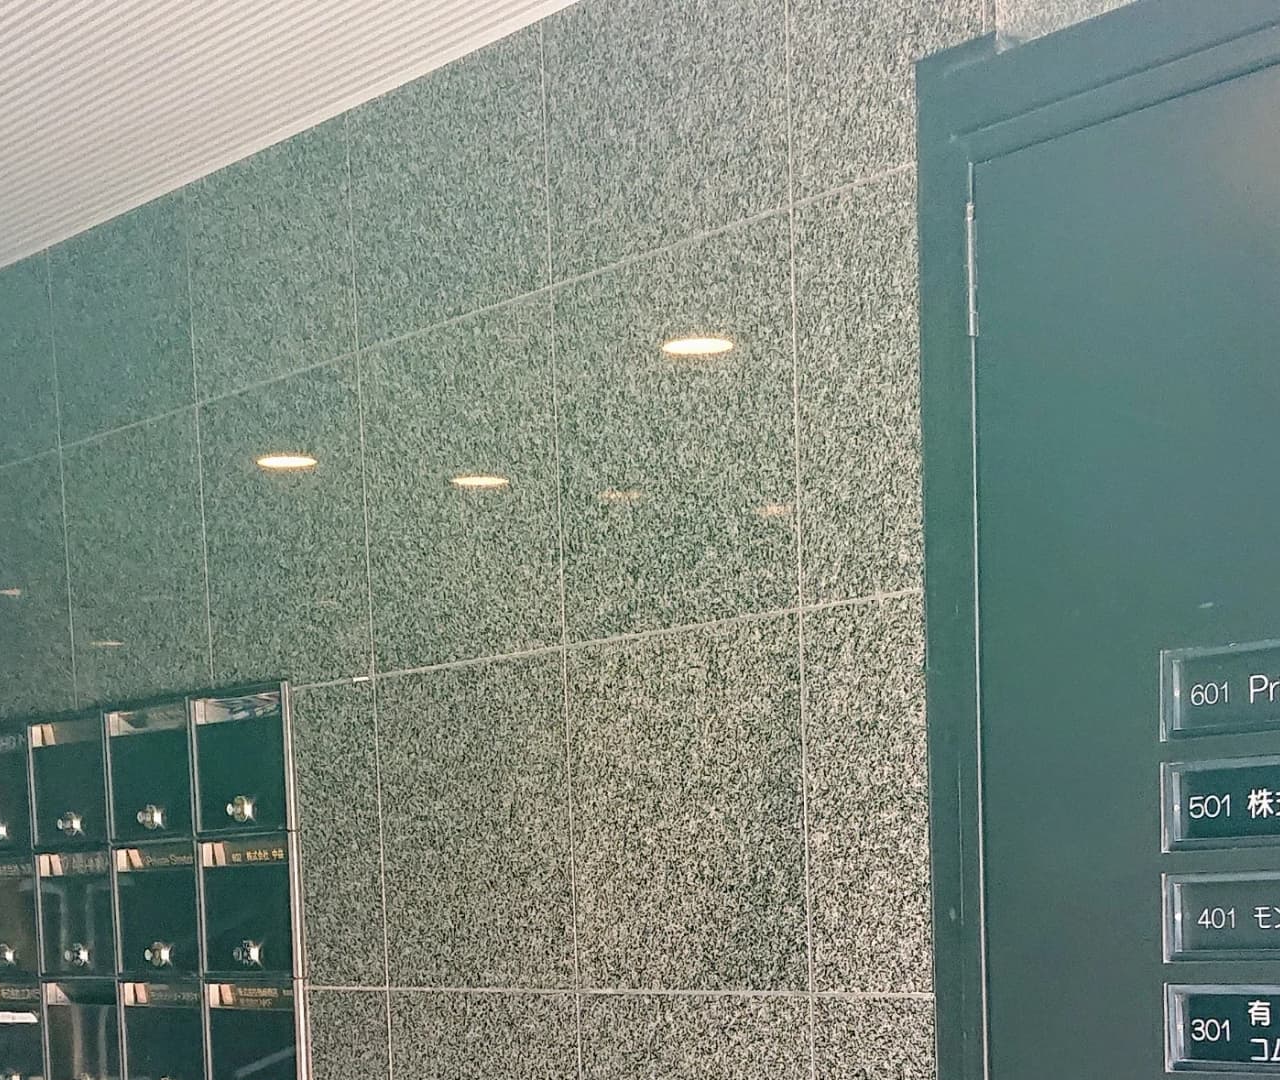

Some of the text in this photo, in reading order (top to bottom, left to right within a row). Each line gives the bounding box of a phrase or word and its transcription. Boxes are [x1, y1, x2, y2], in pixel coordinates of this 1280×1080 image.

[1190, 681, 1228, 706] 601
[1189, 794, 1231, 819] 501
[1197, 907, 1235, 929] 401
[1191, 1018, 1230, 1042] 301
